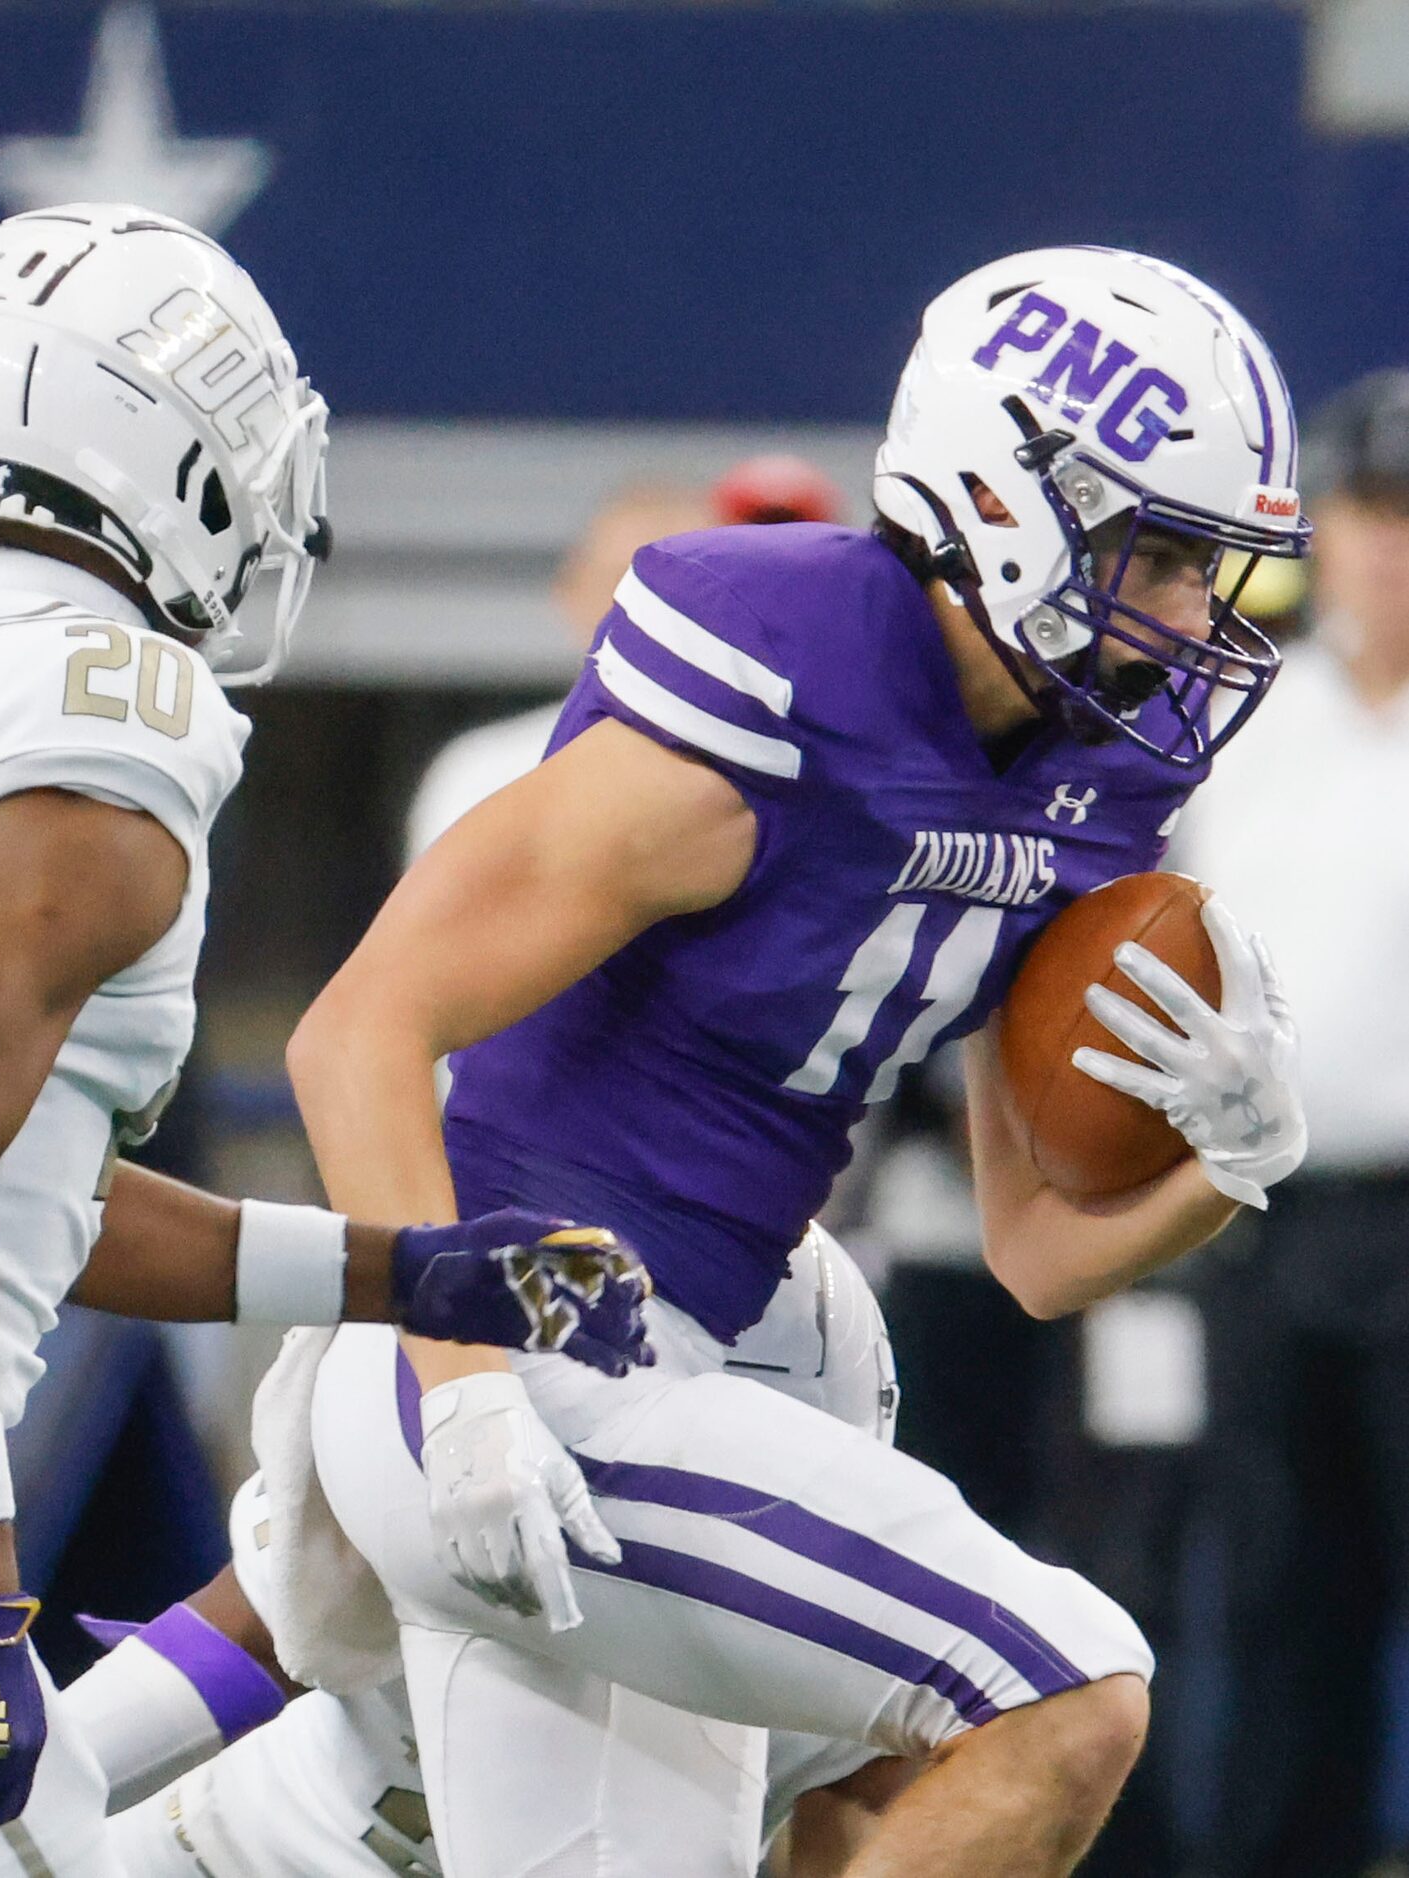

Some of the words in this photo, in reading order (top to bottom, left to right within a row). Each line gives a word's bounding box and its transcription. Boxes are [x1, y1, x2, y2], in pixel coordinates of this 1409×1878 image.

[971, 291, 1188, 462] PNG
[62, 623, 194, 740] 20
[886, 831, 1056, 905] INDIANS
[782, 902, 1004, 1104] 11
